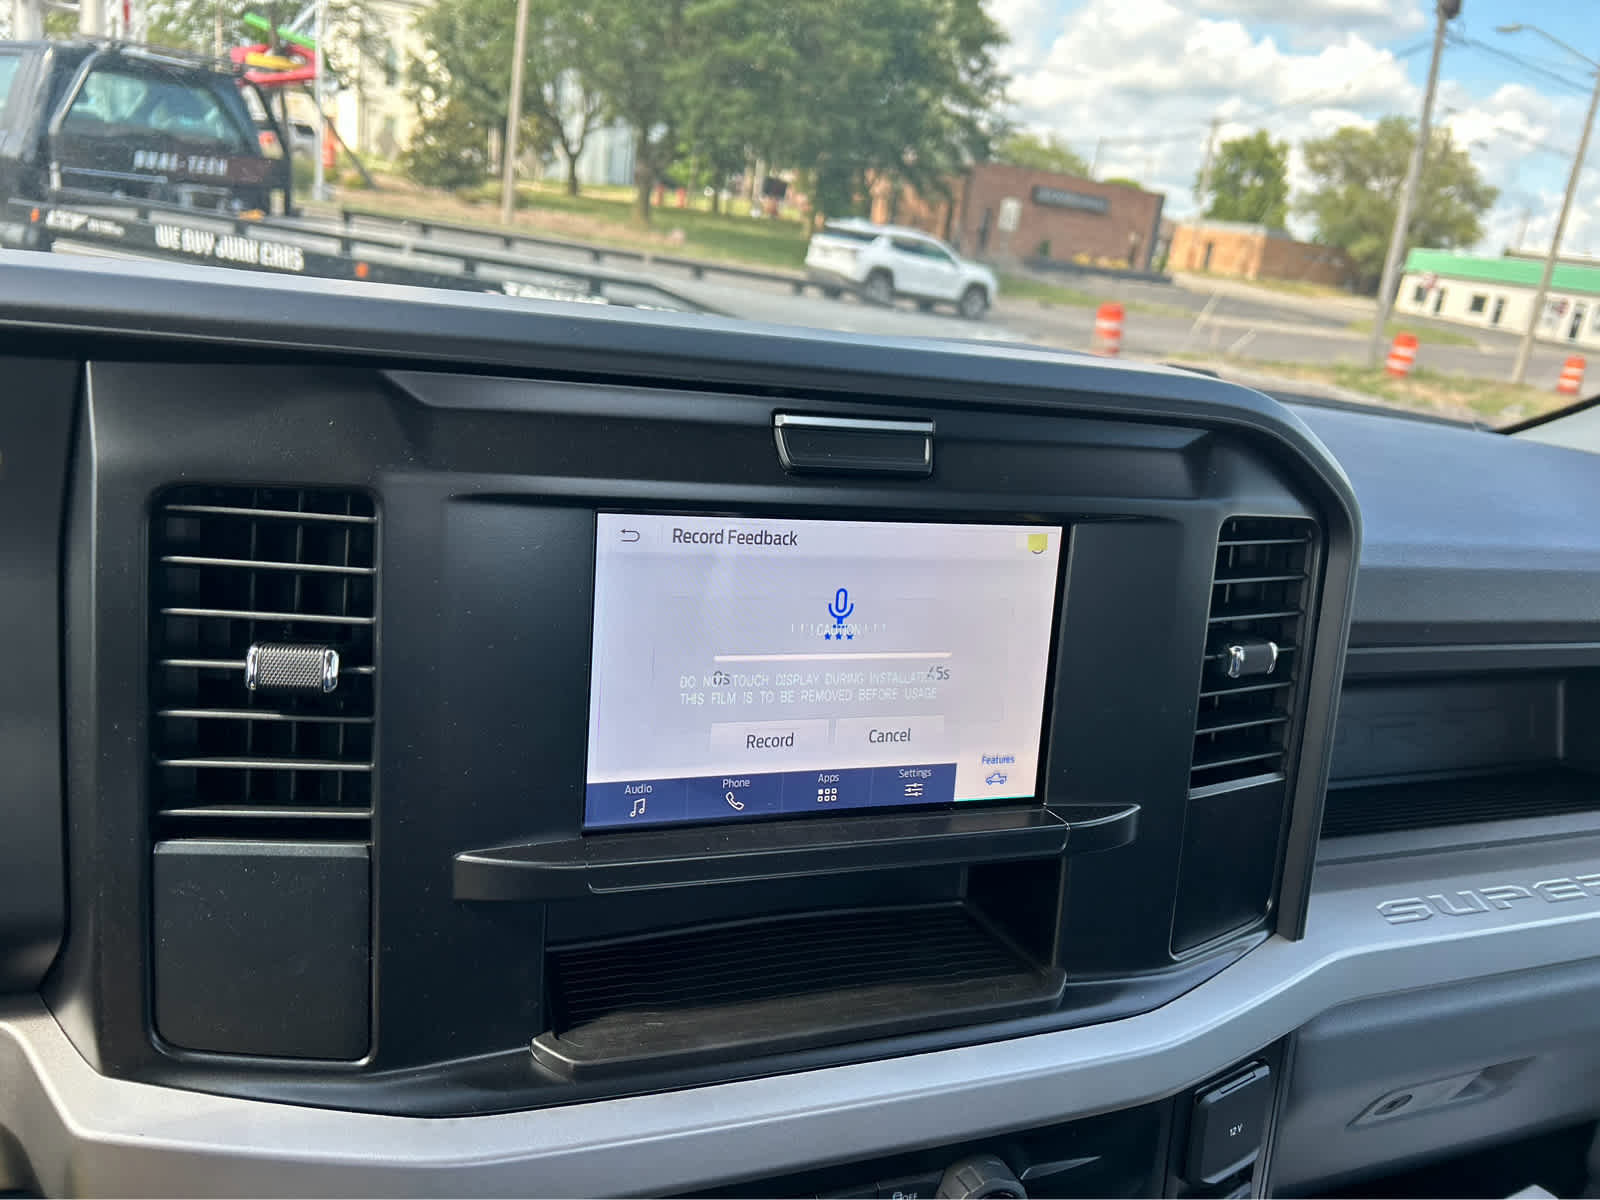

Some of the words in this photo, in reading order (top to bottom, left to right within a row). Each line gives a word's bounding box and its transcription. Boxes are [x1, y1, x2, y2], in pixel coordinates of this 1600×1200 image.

[155, 223, 181, 249] WE
[182, 227, 215, 256] BUY
[215, 234, 258, 265] JUNK
[259, 240, 304, 272] CARS
[672, 527, 724, 545] Record
[727, 529, 798, 546] Feedback
[680, 674, 697, 689] DO
[733, 673, 769, 688] TOUCH
[775, 671, 820, 687] DISPLAY
[825, 671, 864, 686] DURING
[680, 692, 705, 705] THIS
[711, 691, 737, 705] FILM
[743, 690, 753, 704] IS
[760, 690, 776, 704] TO
[780, 689, 796, 704] BE
[800, 688, 852, 704] REMOVED
[858, 687, 897, 701] BEFORE
[904, 686, 937, 700] USAGE
[746, 732, 795, 750] Record
[868, 727, 912, 744] Cancel
[981, 753, 1016, 766] Features
[817, 772, 840, 785] Apps
[898, 767, 933, 780] Settings
[624, 783, 653, 796] Audio
[722, 777, 751, 790] Phone
